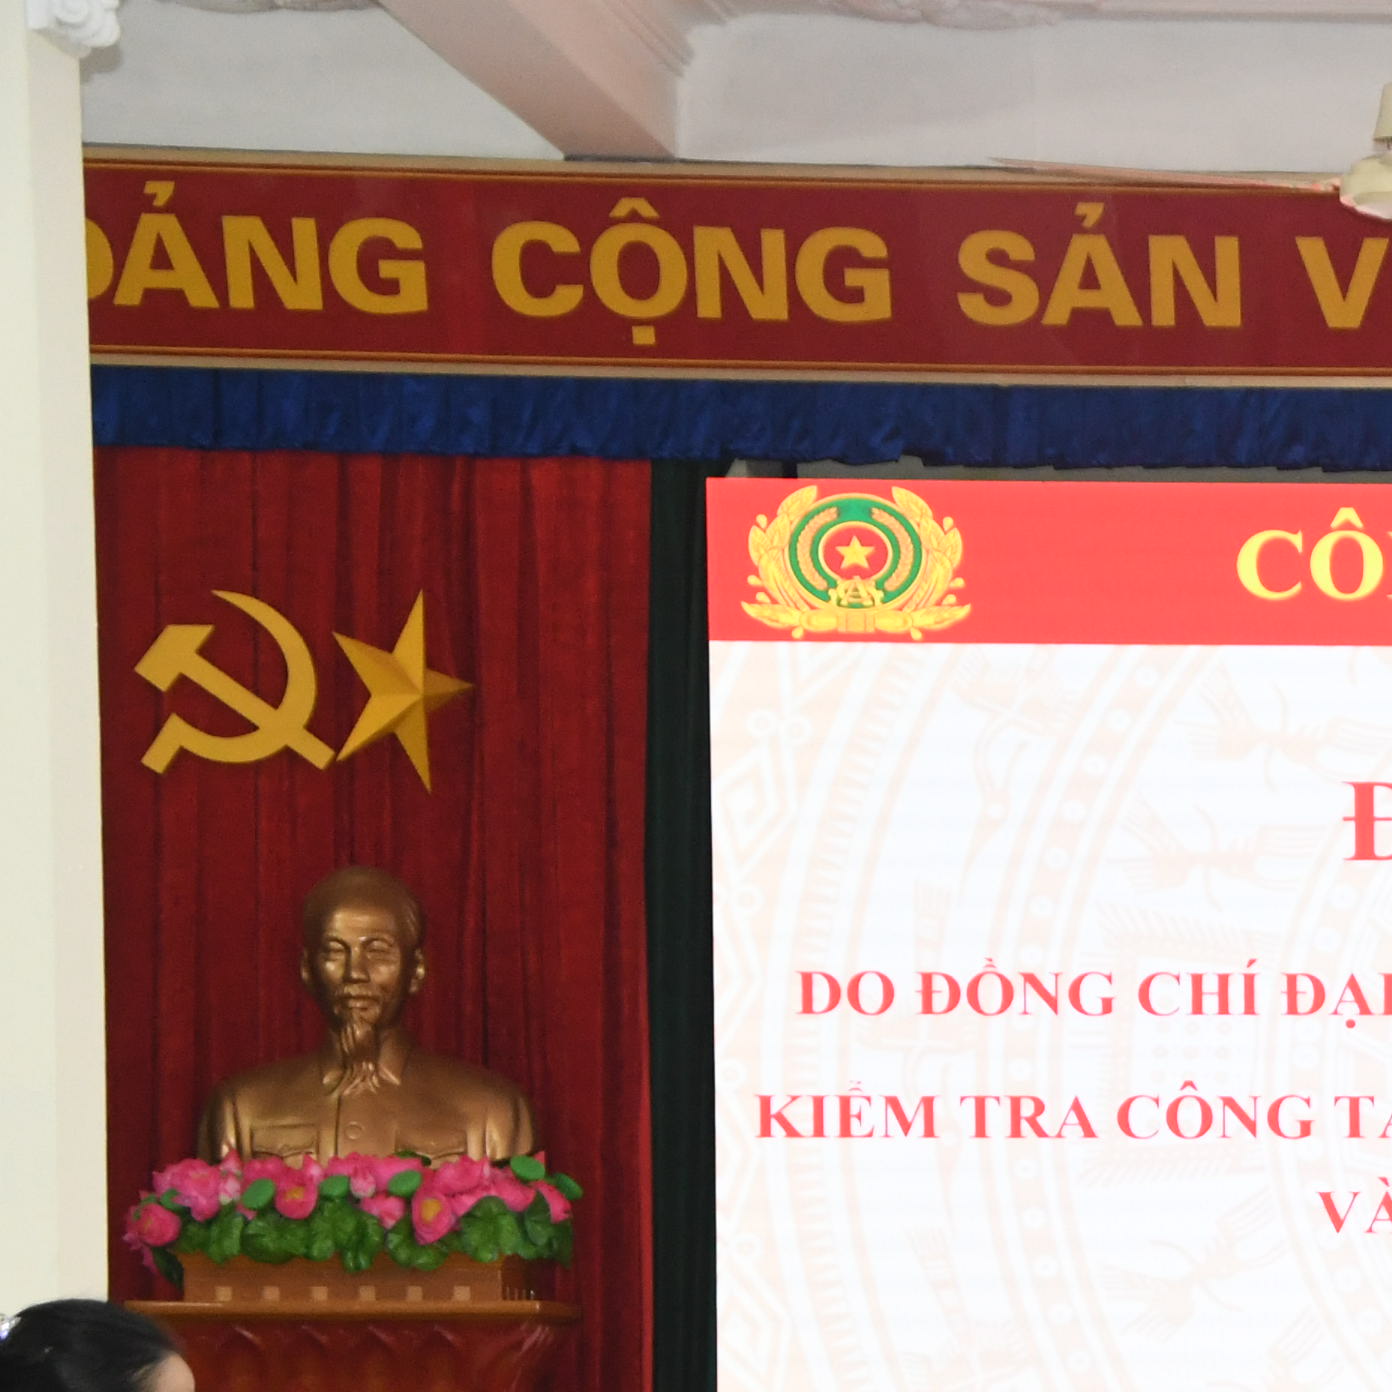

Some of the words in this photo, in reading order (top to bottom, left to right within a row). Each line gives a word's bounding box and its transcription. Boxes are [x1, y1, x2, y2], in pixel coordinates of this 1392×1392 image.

[491, 196, 893, 345] CỘNG
[958, 202, 1242, 328] SẢN
[797, 970, 895, 1017] DO
[916, 957, 1116, 1018] ĐỒNG
[1136, 958, 1259, 1018] CHÍ
[958, 1094, 1100, 1140] TRA
[1115, 1079, 1315, 1141] CÔNG
